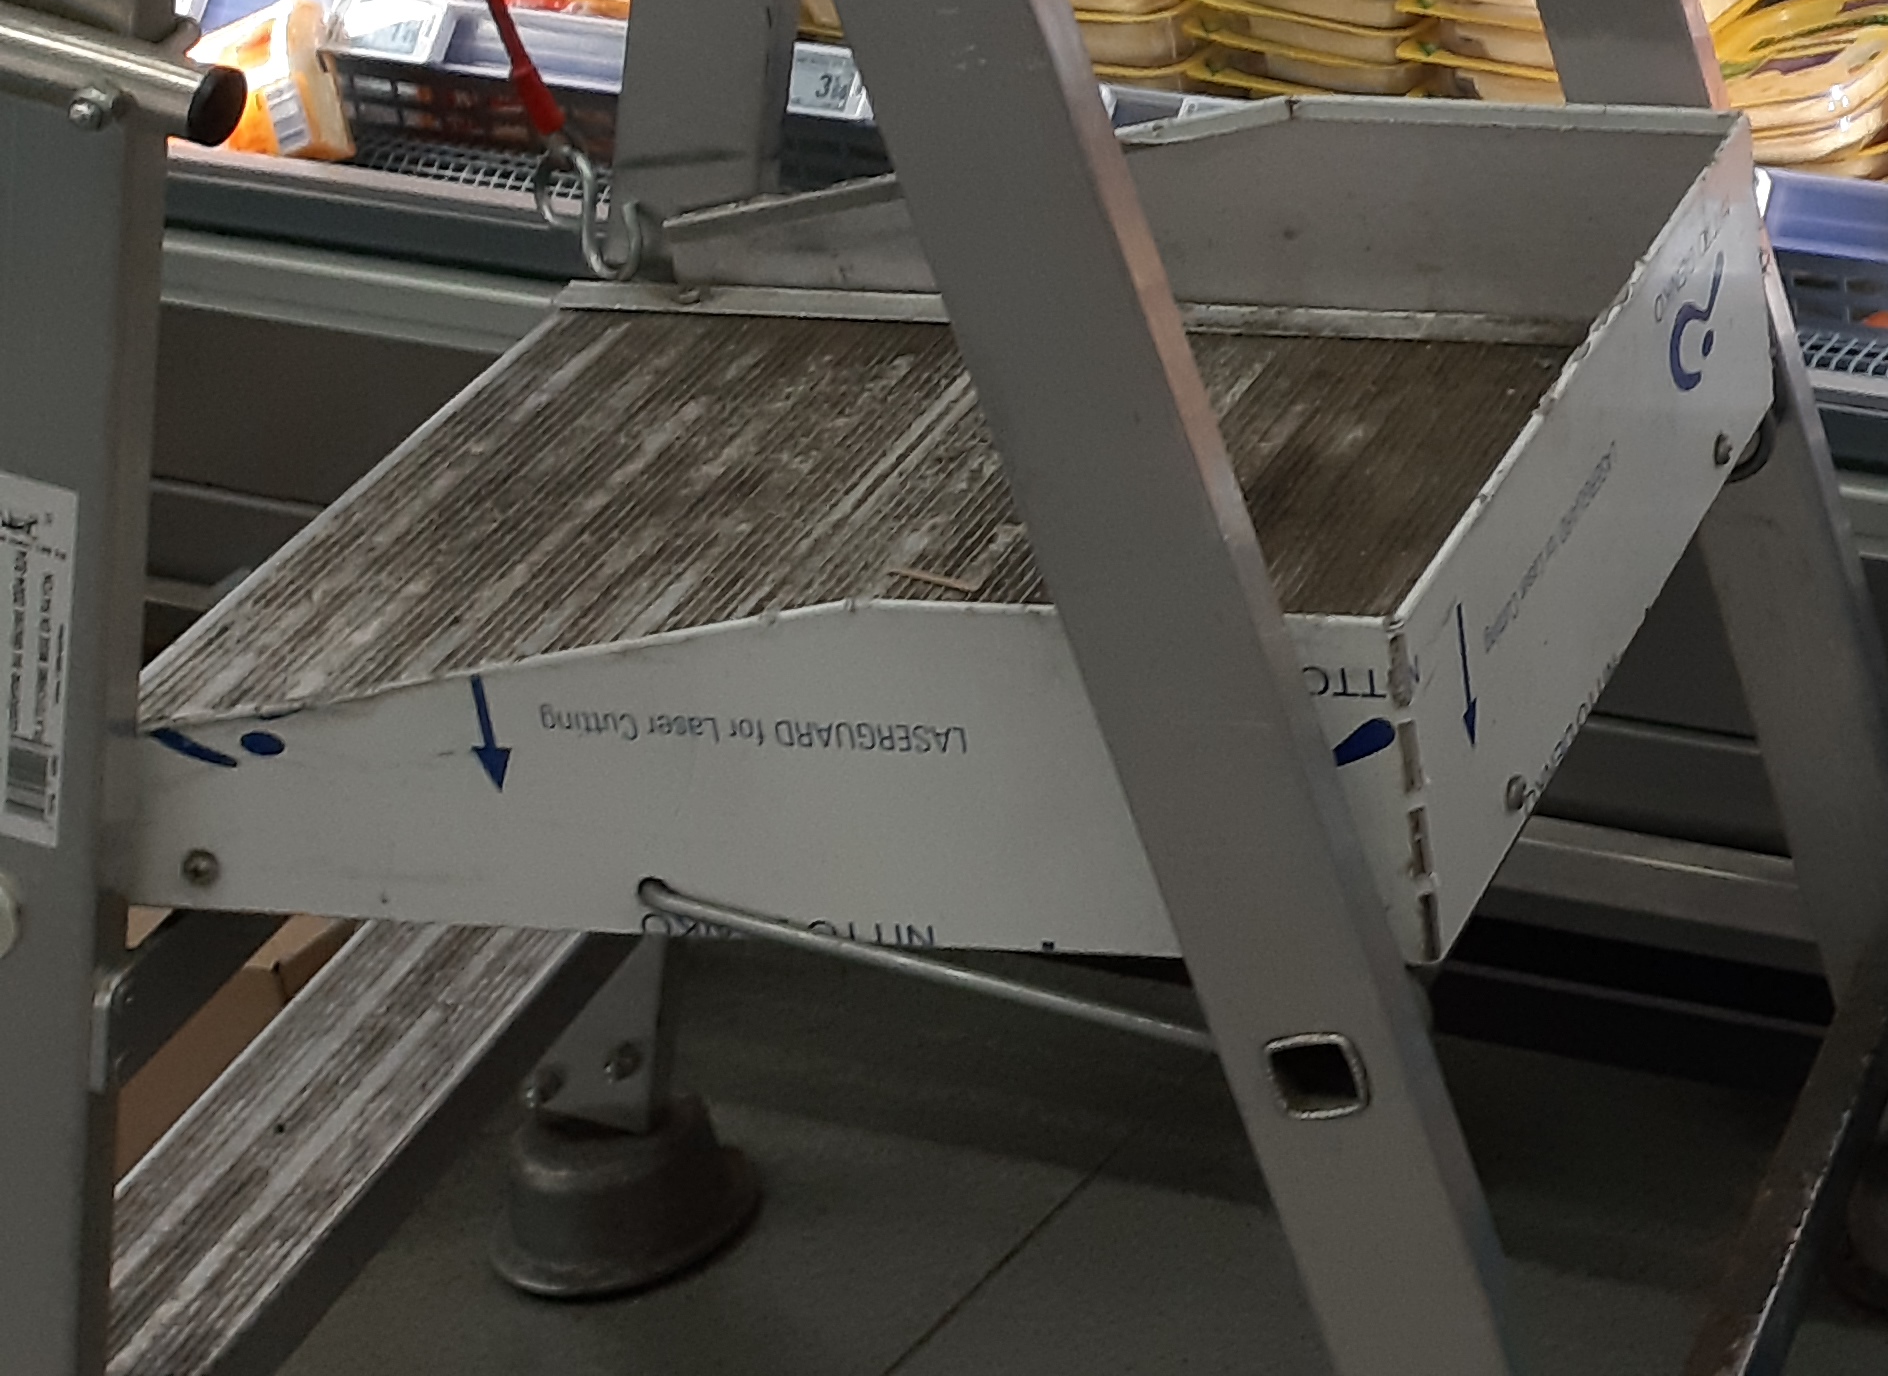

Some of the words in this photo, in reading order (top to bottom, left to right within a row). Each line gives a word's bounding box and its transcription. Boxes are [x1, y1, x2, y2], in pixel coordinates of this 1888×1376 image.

[540, 702, 643, 736] Cutting
[649, 713, 722, 741] Laser
[726, 716, 768, 743] for
[773, 718, 969, 755] LASERGUARD
